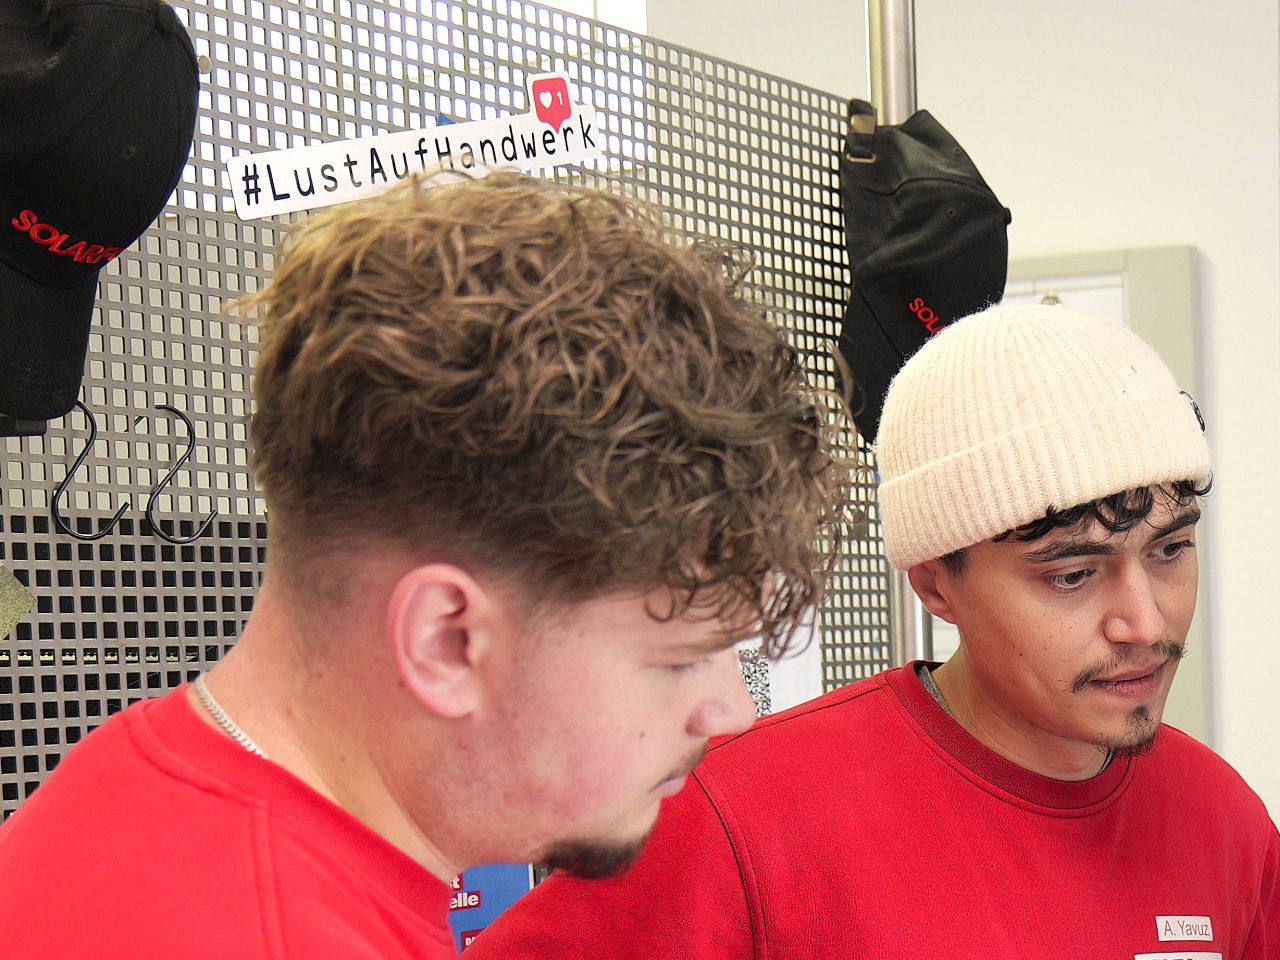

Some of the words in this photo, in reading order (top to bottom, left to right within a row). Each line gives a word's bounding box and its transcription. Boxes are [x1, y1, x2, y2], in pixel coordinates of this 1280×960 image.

[241, 114, 597, 206] #LustAufHandwerk
[1164, 920, 1176, 936] A.
[1178, 920, 1210, 936] Yavuz
